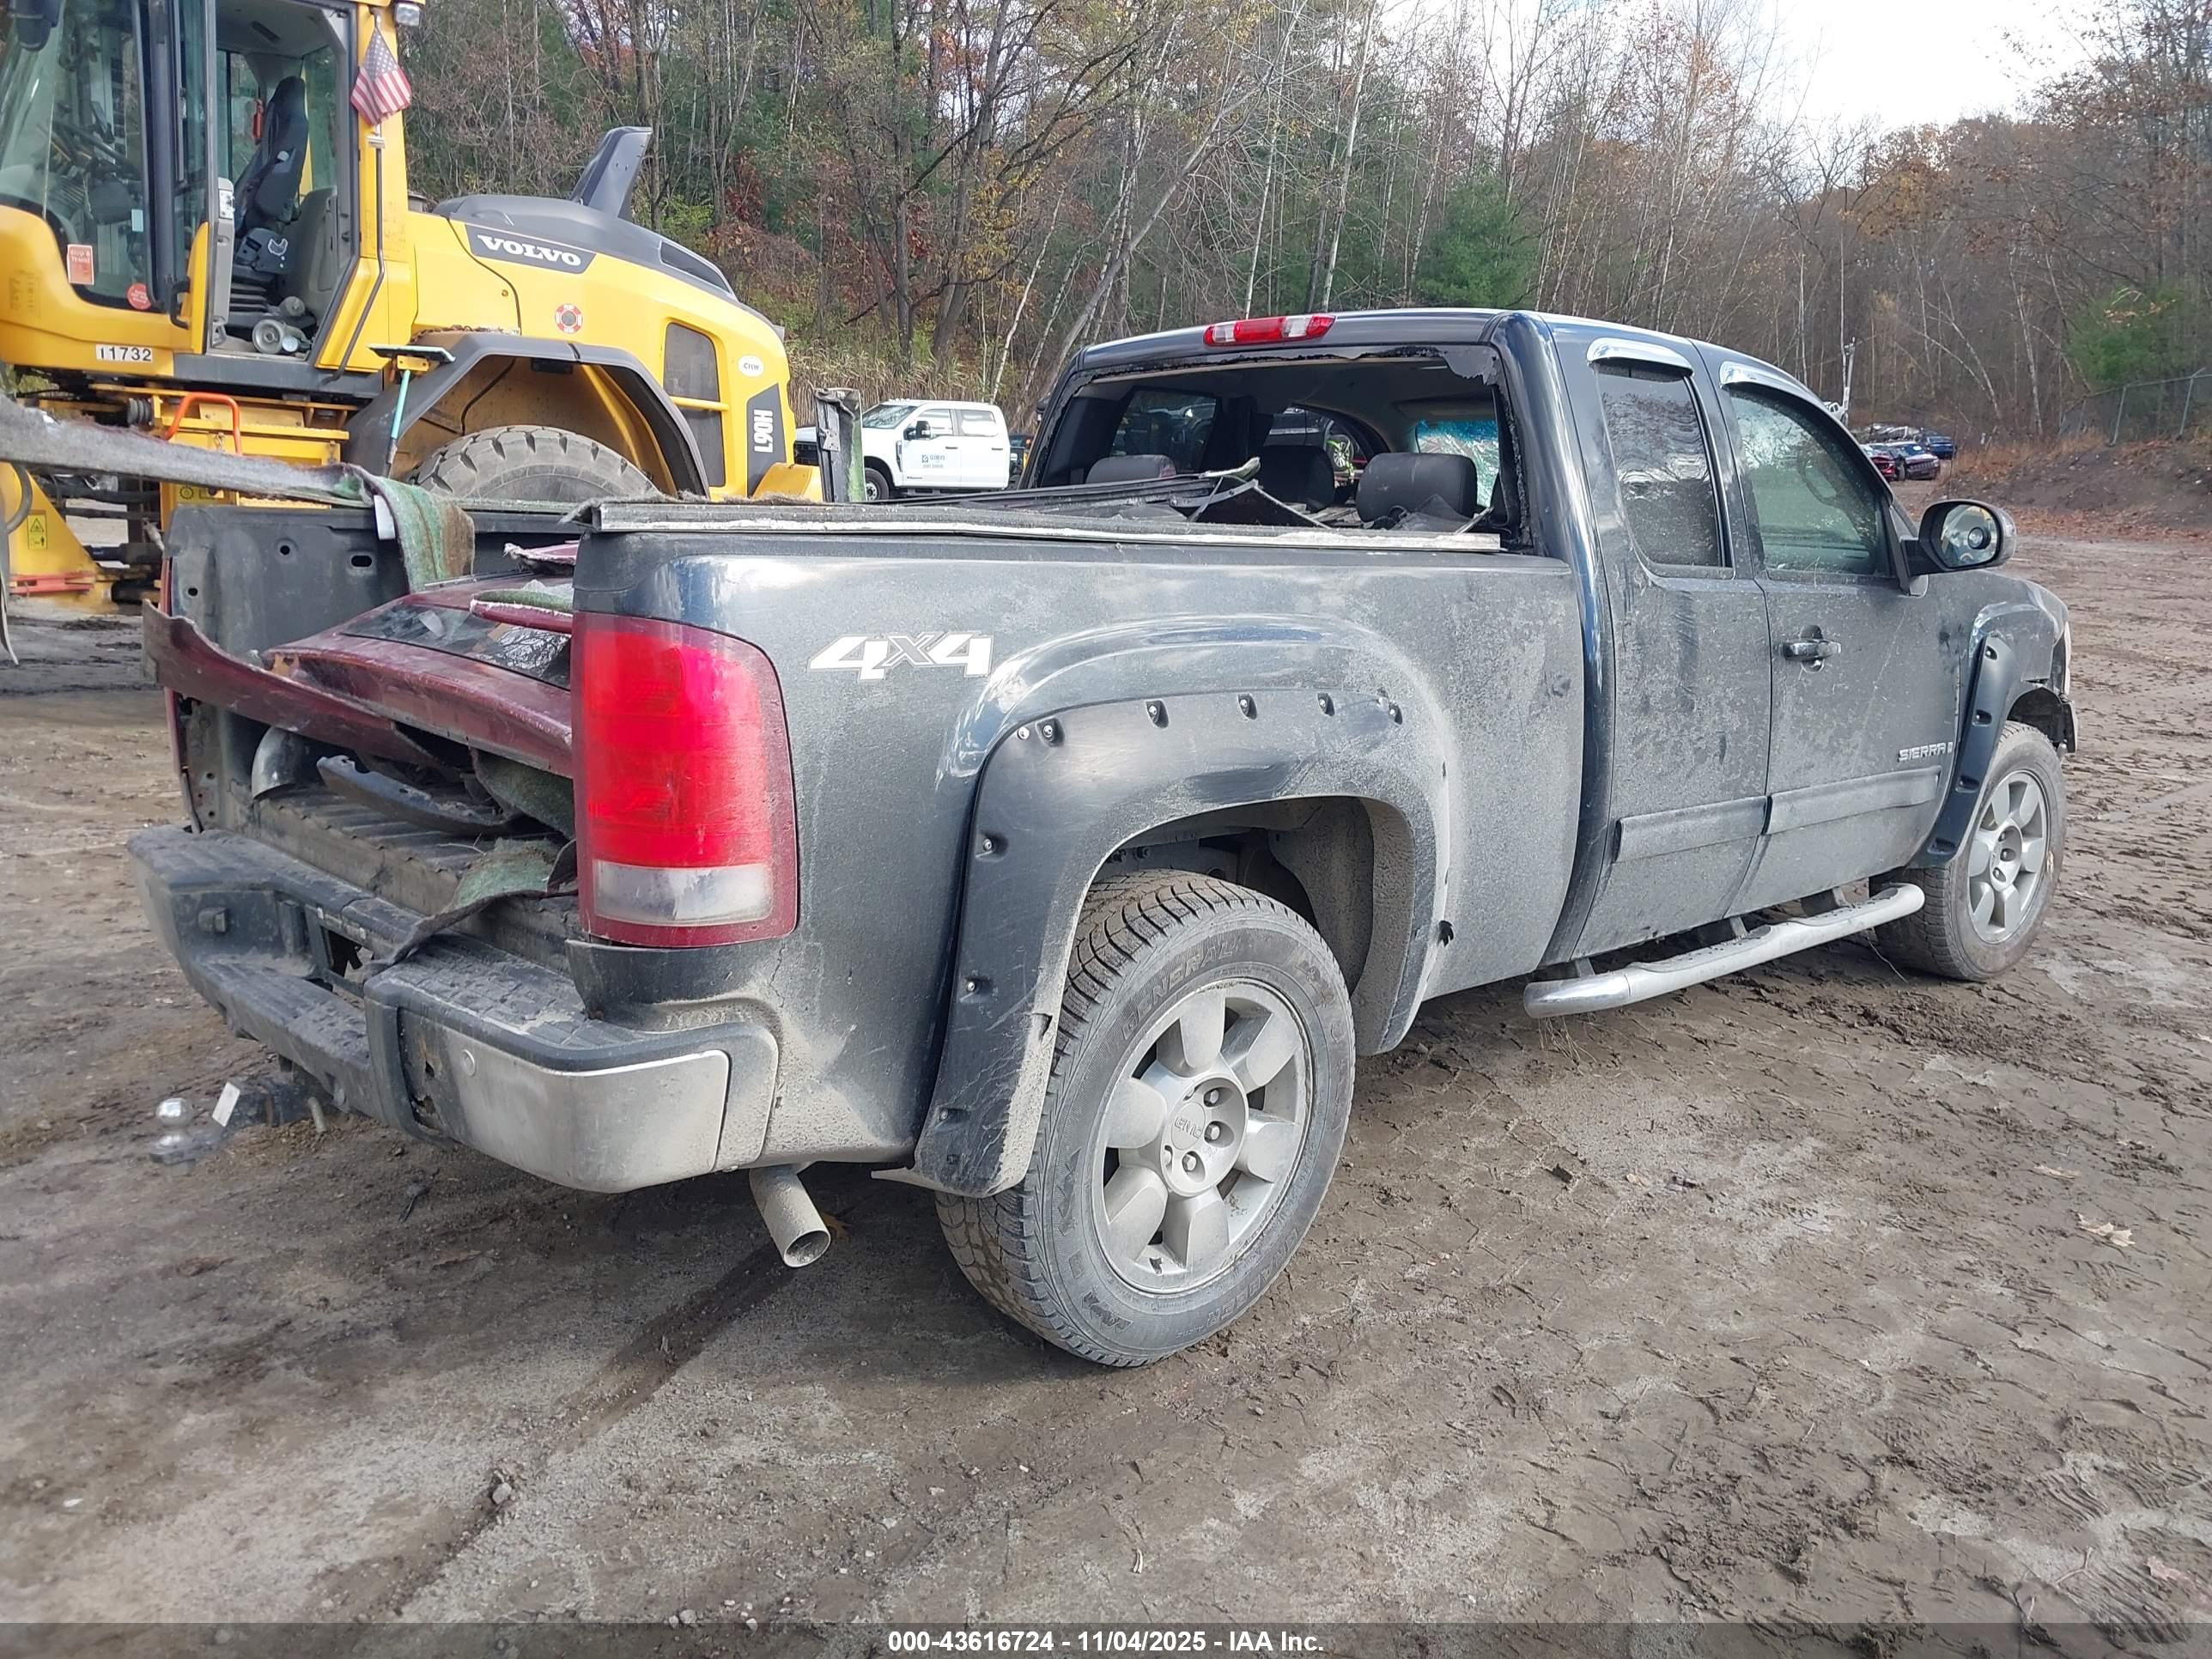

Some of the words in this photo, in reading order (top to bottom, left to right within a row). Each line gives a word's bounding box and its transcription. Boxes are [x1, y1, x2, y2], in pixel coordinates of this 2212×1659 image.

[477, 234, 582, 266] VOLVO
[100, 346, 152, 362] 11732
[753, 409, 774, 453] L90H
[1898, 742, 1947, 762] SIERRA
[1174, 1116, 1202, 1140] GMC
